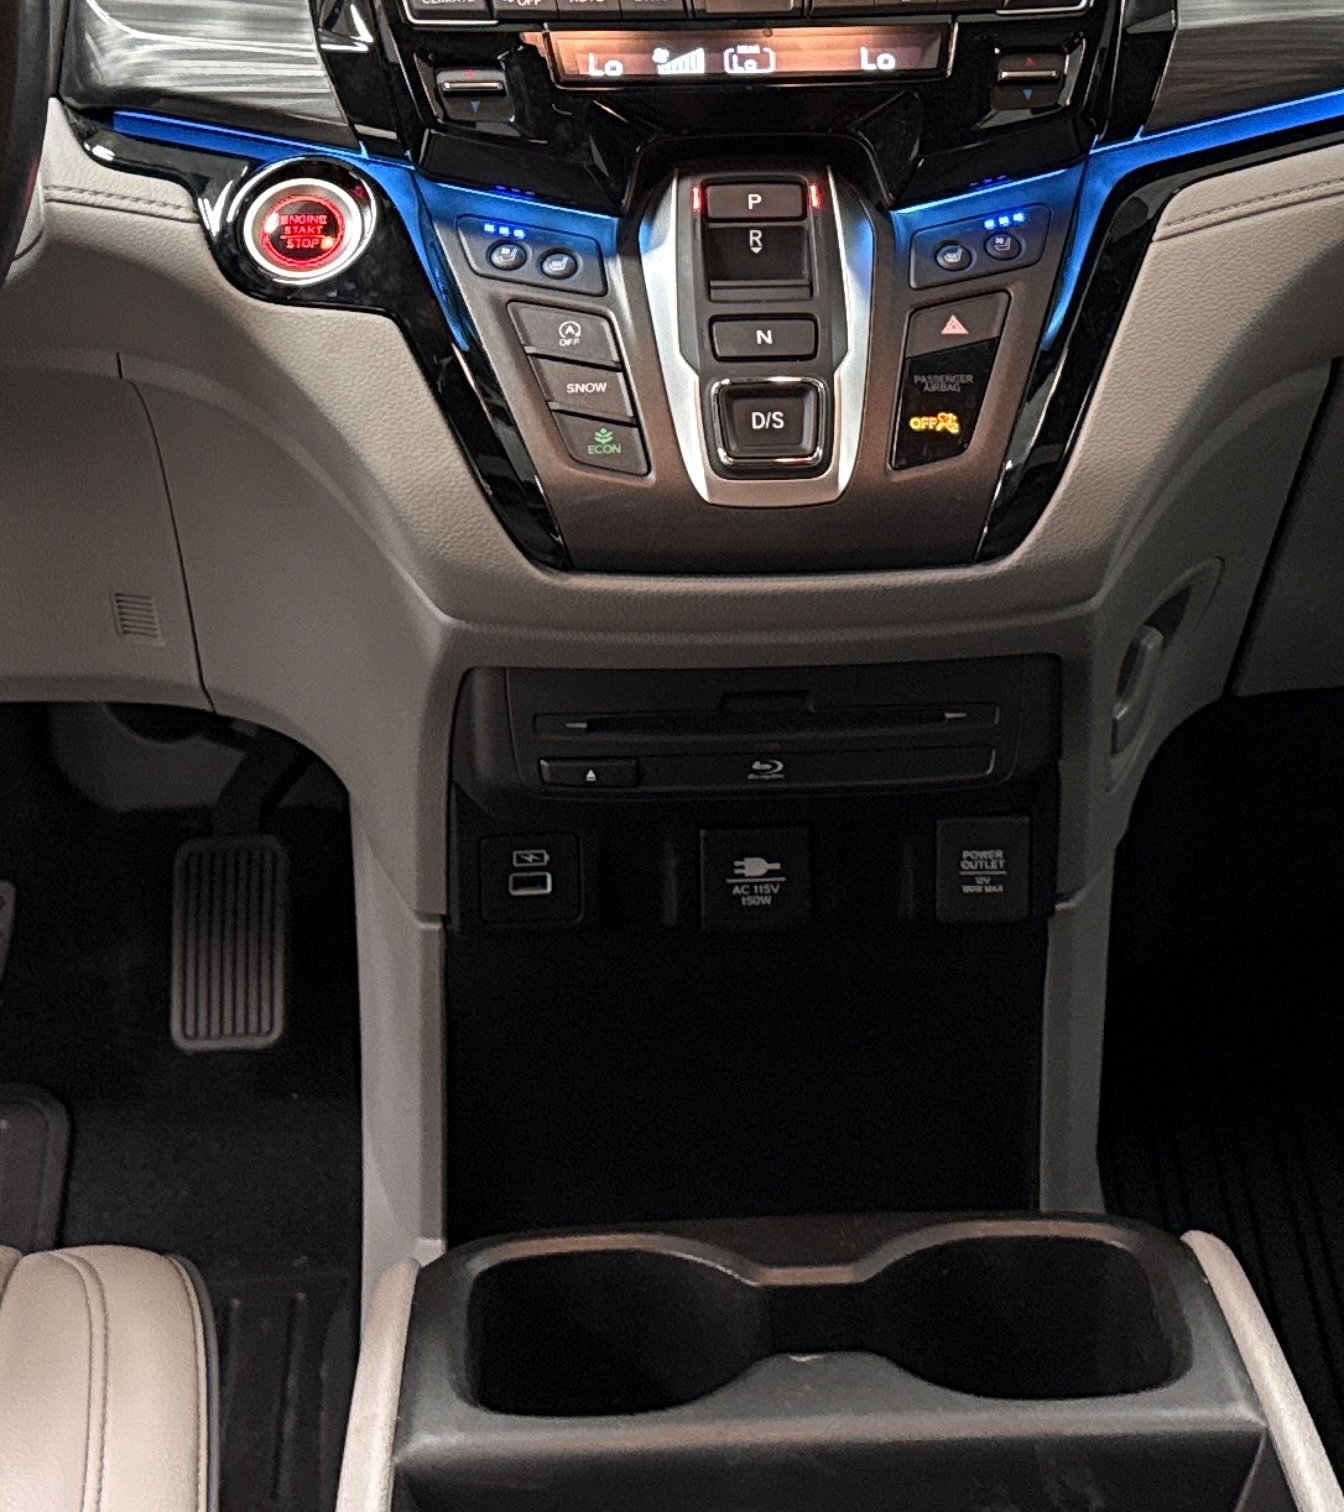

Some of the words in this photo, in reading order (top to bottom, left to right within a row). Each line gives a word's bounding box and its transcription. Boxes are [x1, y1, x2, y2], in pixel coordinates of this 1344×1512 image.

[860, 46, 896, 70] Lo
[588, 52, 623, 76] Lo
[748, 194, 762, 209] P
[280, 214, 328, 225] ENGINE
[284, 225, 323, 235] START
[749, 229, 762, 246] R
[286, 238, 321, 249] STOP
[559, 338, 580, 347] OFF
[756, 330, 773, 344] N
[913, 374, 974, 384] PASSENGER
[566, 382, 607, 394] SNOW
[751, 411, 785, 429] D/S
[909, 416, 937, 430] OFF
[587, 443, 621, 454] ECON
[962, 849, 1004, 860] POWER
[960, 859, 1006, 870] OUTLET
[732, 885, 751, 896] AC
[753, 883, 781, 895] 115V
[741, 895, 772, 906] 150W
